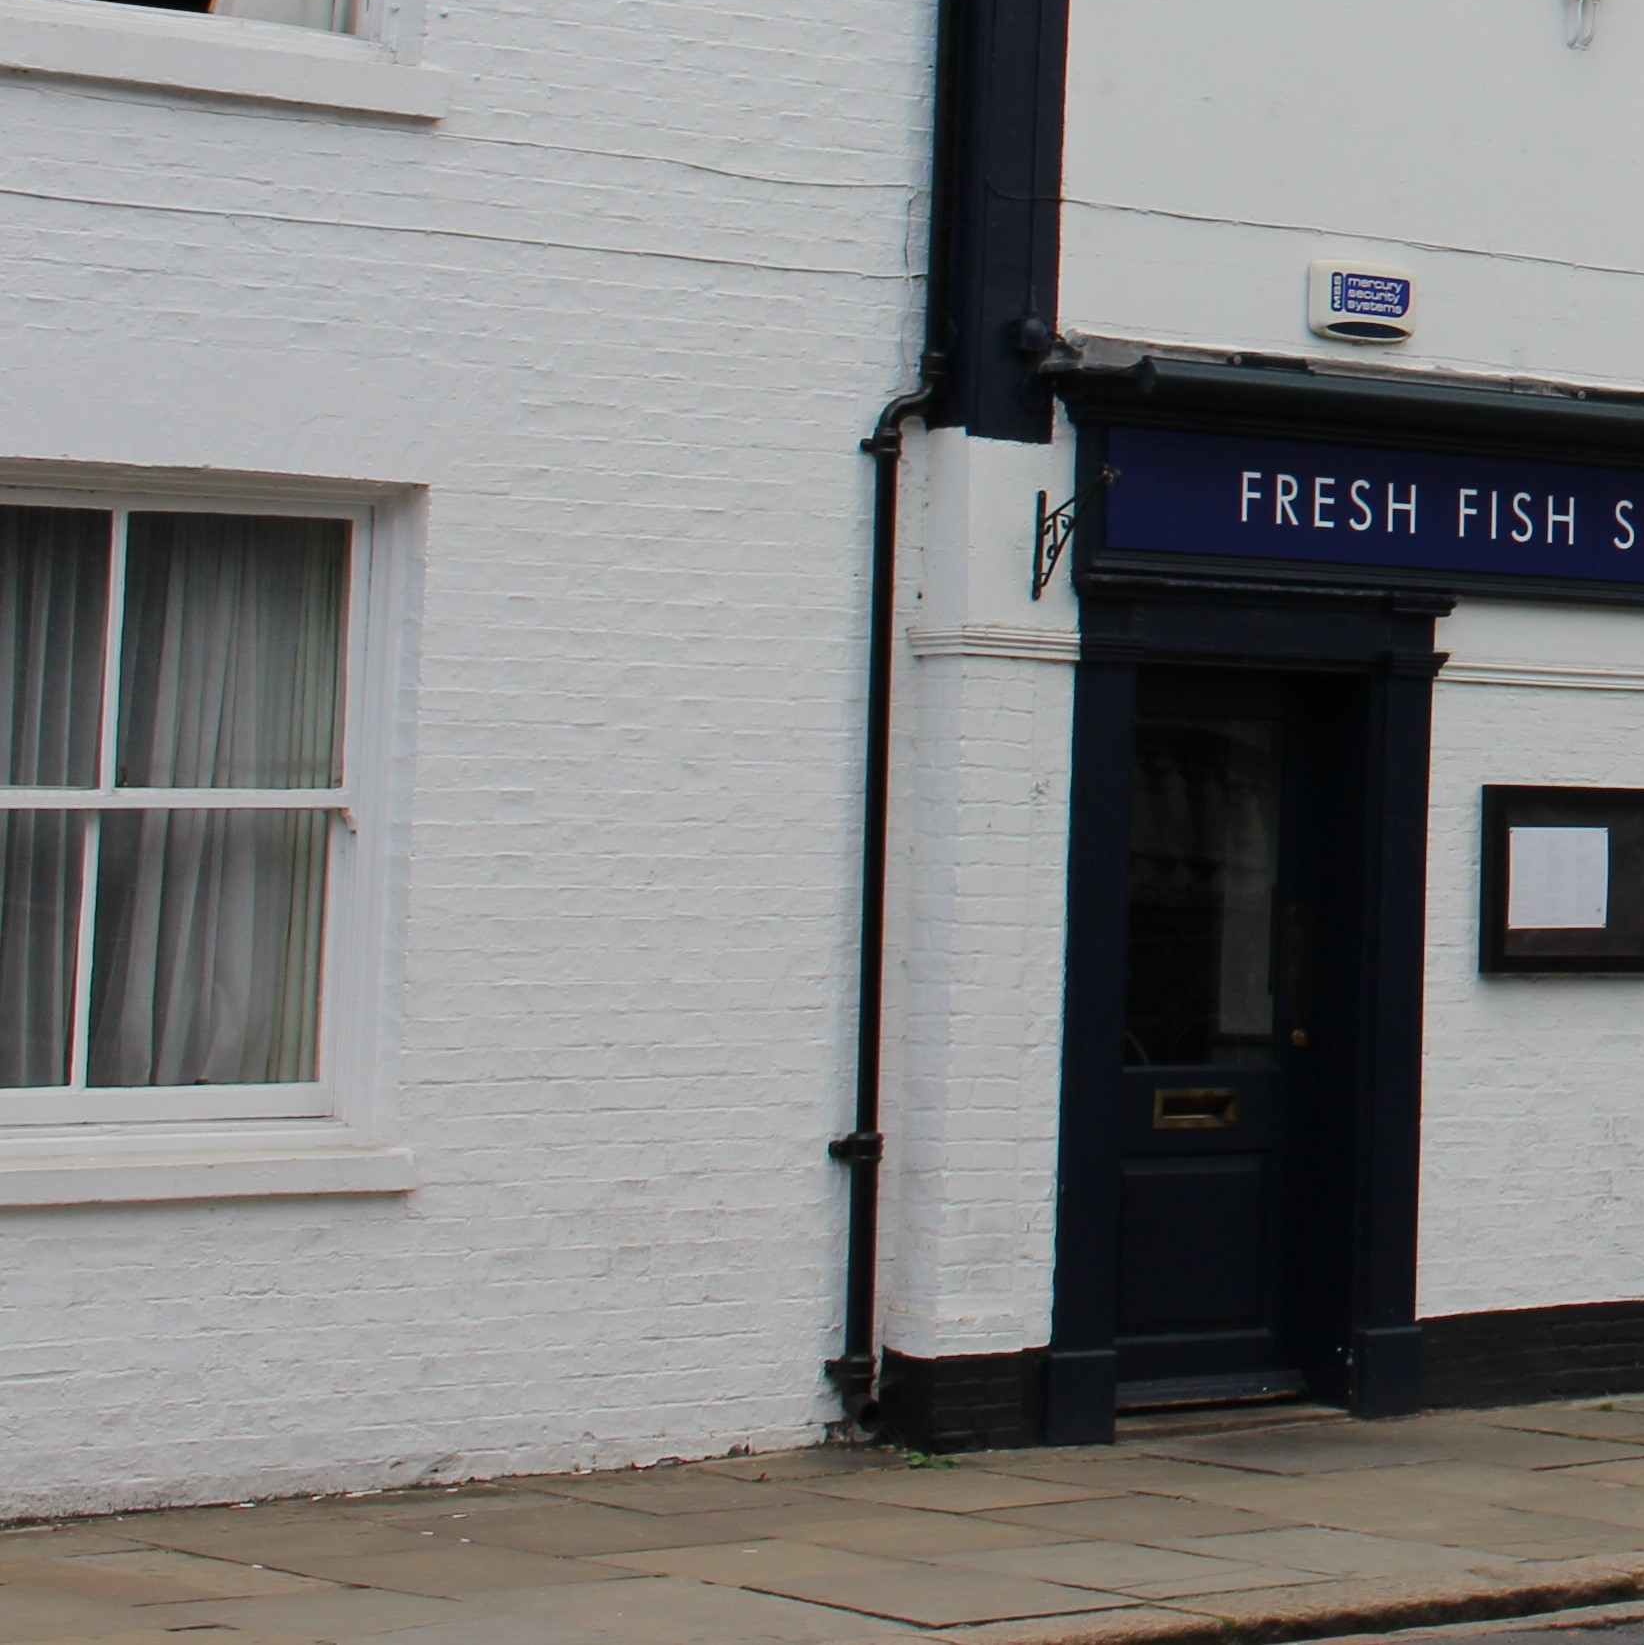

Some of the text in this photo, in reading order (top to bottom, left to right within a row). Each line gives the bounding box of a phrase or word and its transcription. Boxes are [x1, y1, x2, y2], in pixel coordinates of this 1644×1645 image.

[1348, 277, 1402, 293] mercury
[1347, 288, 1400, 304] security
[1347, 300, 1402, 314] systems
[1241, 471, 1417, 534] FRESH
[1458, 488, 1575, 545] FISH
